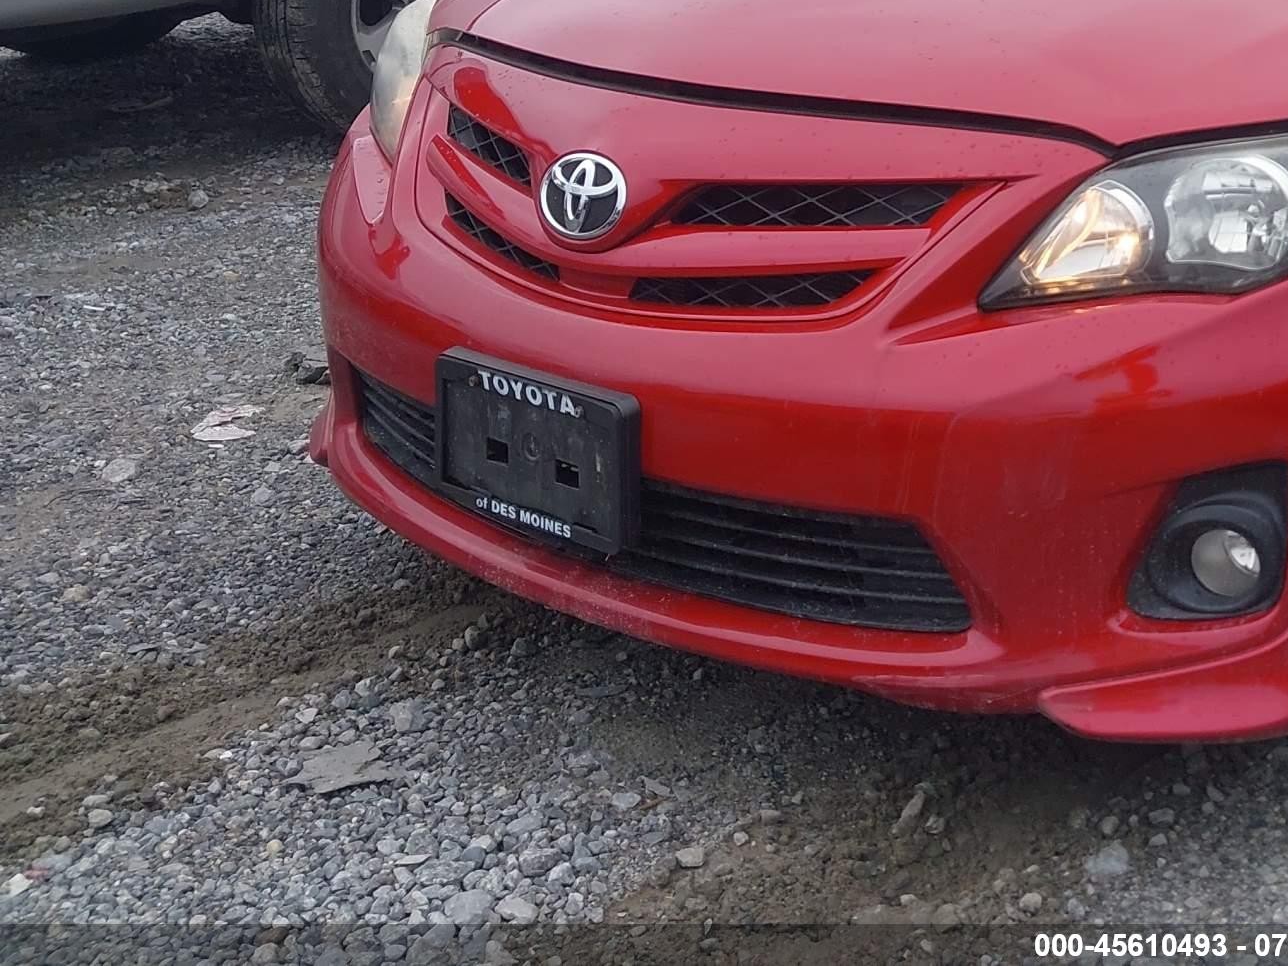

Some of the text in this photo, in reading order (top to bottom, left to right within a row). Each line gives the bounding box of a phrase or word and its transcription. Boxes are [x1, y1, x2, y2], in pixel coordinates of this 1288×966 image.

[477, 369, 577, 418] TOYOTA
[475, 497, 572, 539] of DES MOINES
